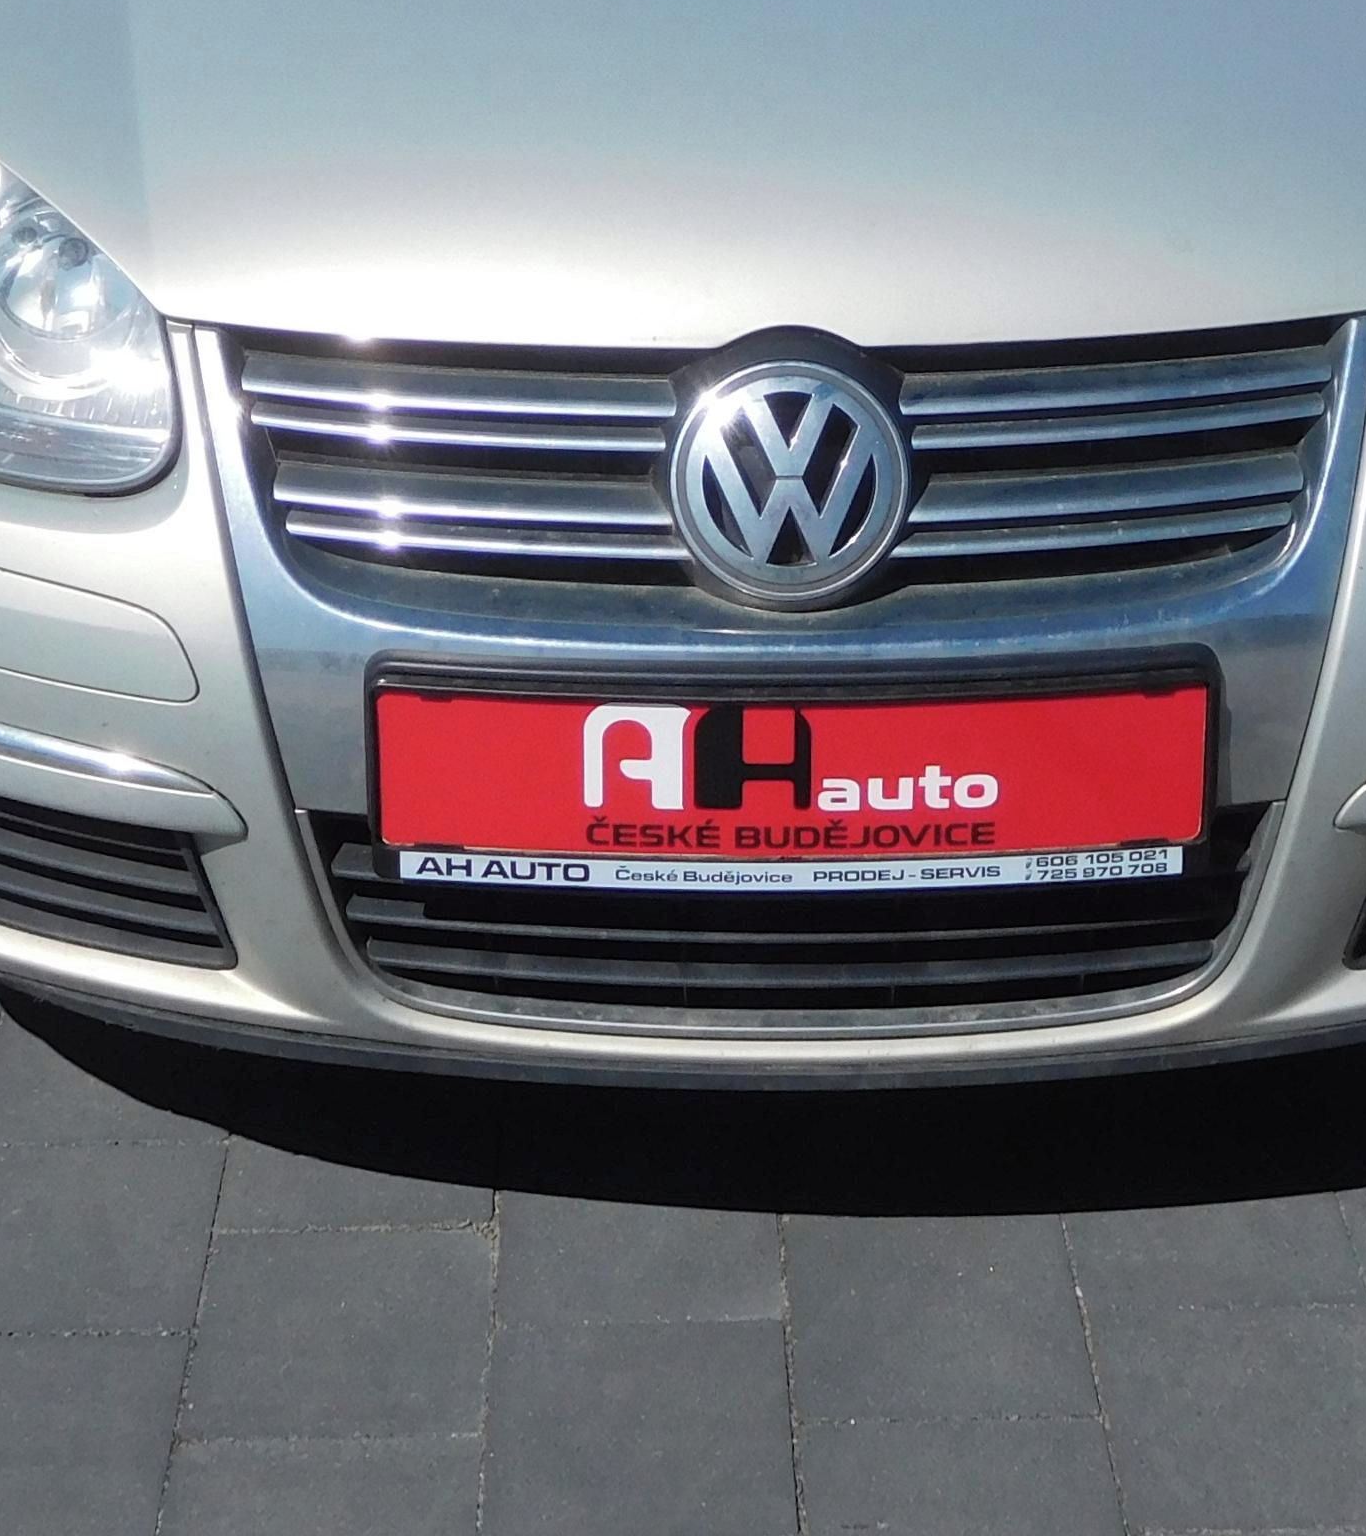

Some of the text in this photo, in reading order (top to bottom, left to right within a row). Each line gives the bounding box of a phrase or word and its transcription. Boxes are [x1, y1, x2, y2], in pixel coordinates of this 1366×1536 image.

[586, 816, 996, 850] ČESKÉ BUDĚJOVICE
[1036, 849, 1168, 868] 606 105 021
[416, 856, 590, 882] AH AUTO
[615, 865, 793, 885] České Budějovice
[1037, 862, 1168, 881] 725 970 708
